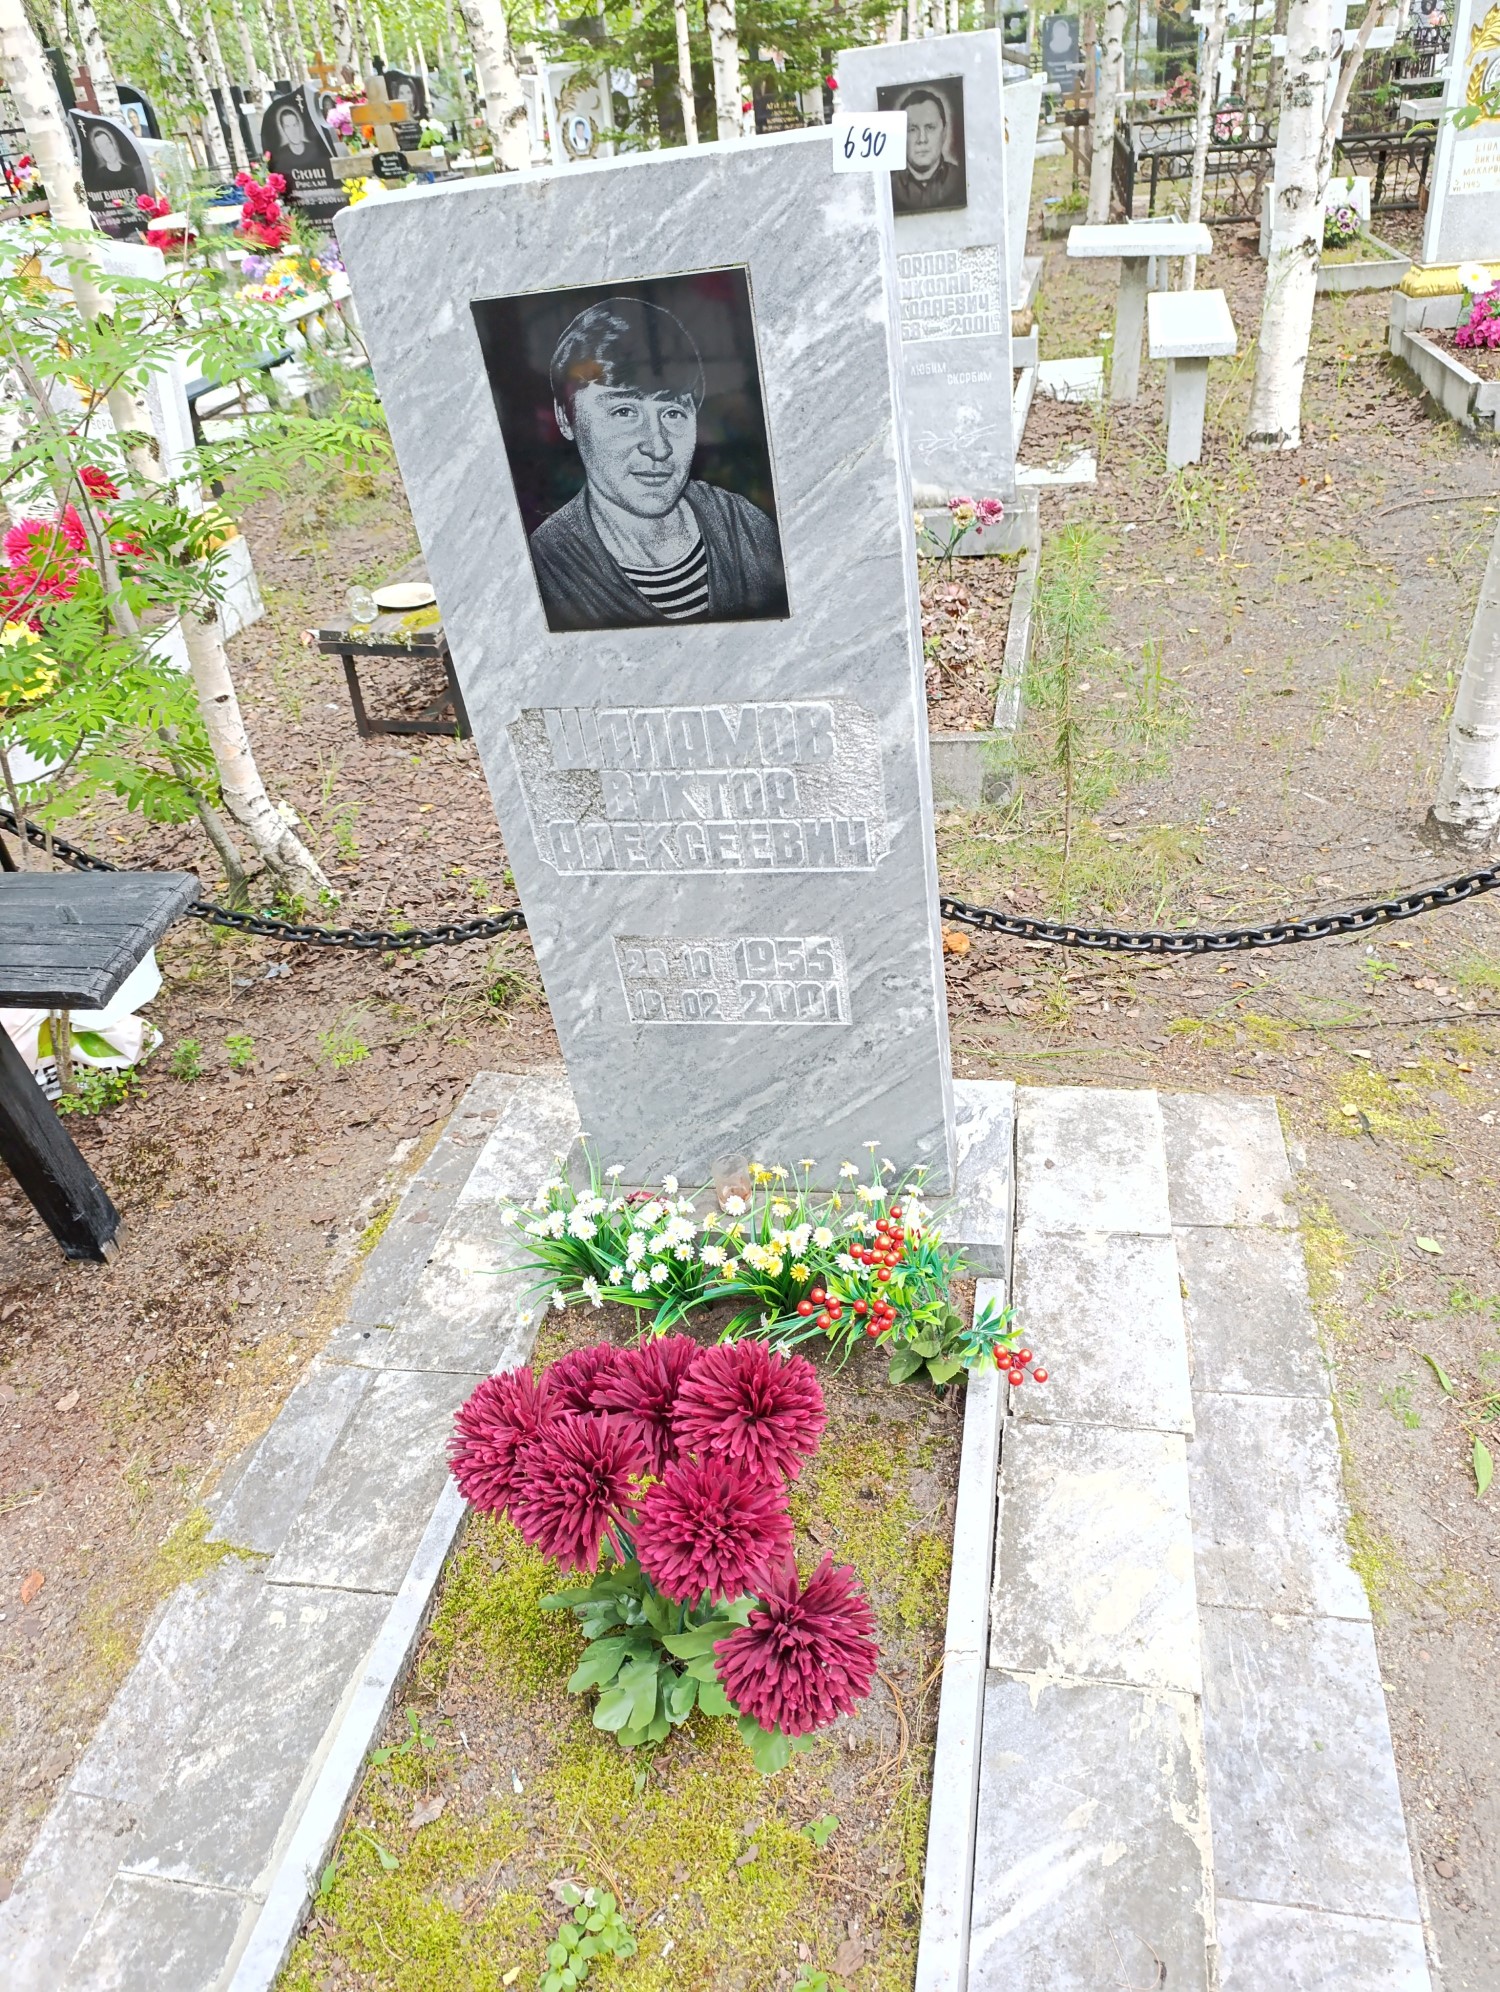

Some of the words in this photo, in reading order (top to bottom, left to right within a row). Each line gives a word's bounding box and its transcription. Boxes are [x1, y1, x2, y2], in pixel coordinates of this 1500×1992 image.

[844, 126, 886, 158] 690
[1463, 165, 1500, 176] МАКАРО
[900, 252, 958, 279] ОРЛОВ
[900, 271, 971, 299] ИКОЛАЙ
[900, 293, 989, 320] КОЛАЕВИЧ
[951, 315, 990, 336] 2001
[910, 361, 947, 376] ЛЮБИМ
[947, 370, 993, 385] СКОРБИМ
[600, 770, 801, 821] ВИКТОР
[549, 818, 874, 869] АЛЕКСЕЕВИЧ
[683, 947, 714, 979] 10
[735, 938, 835, 980] 1955
[682, 988, 724, 1020] 02
[738, 981, 844, 1021] 2001
